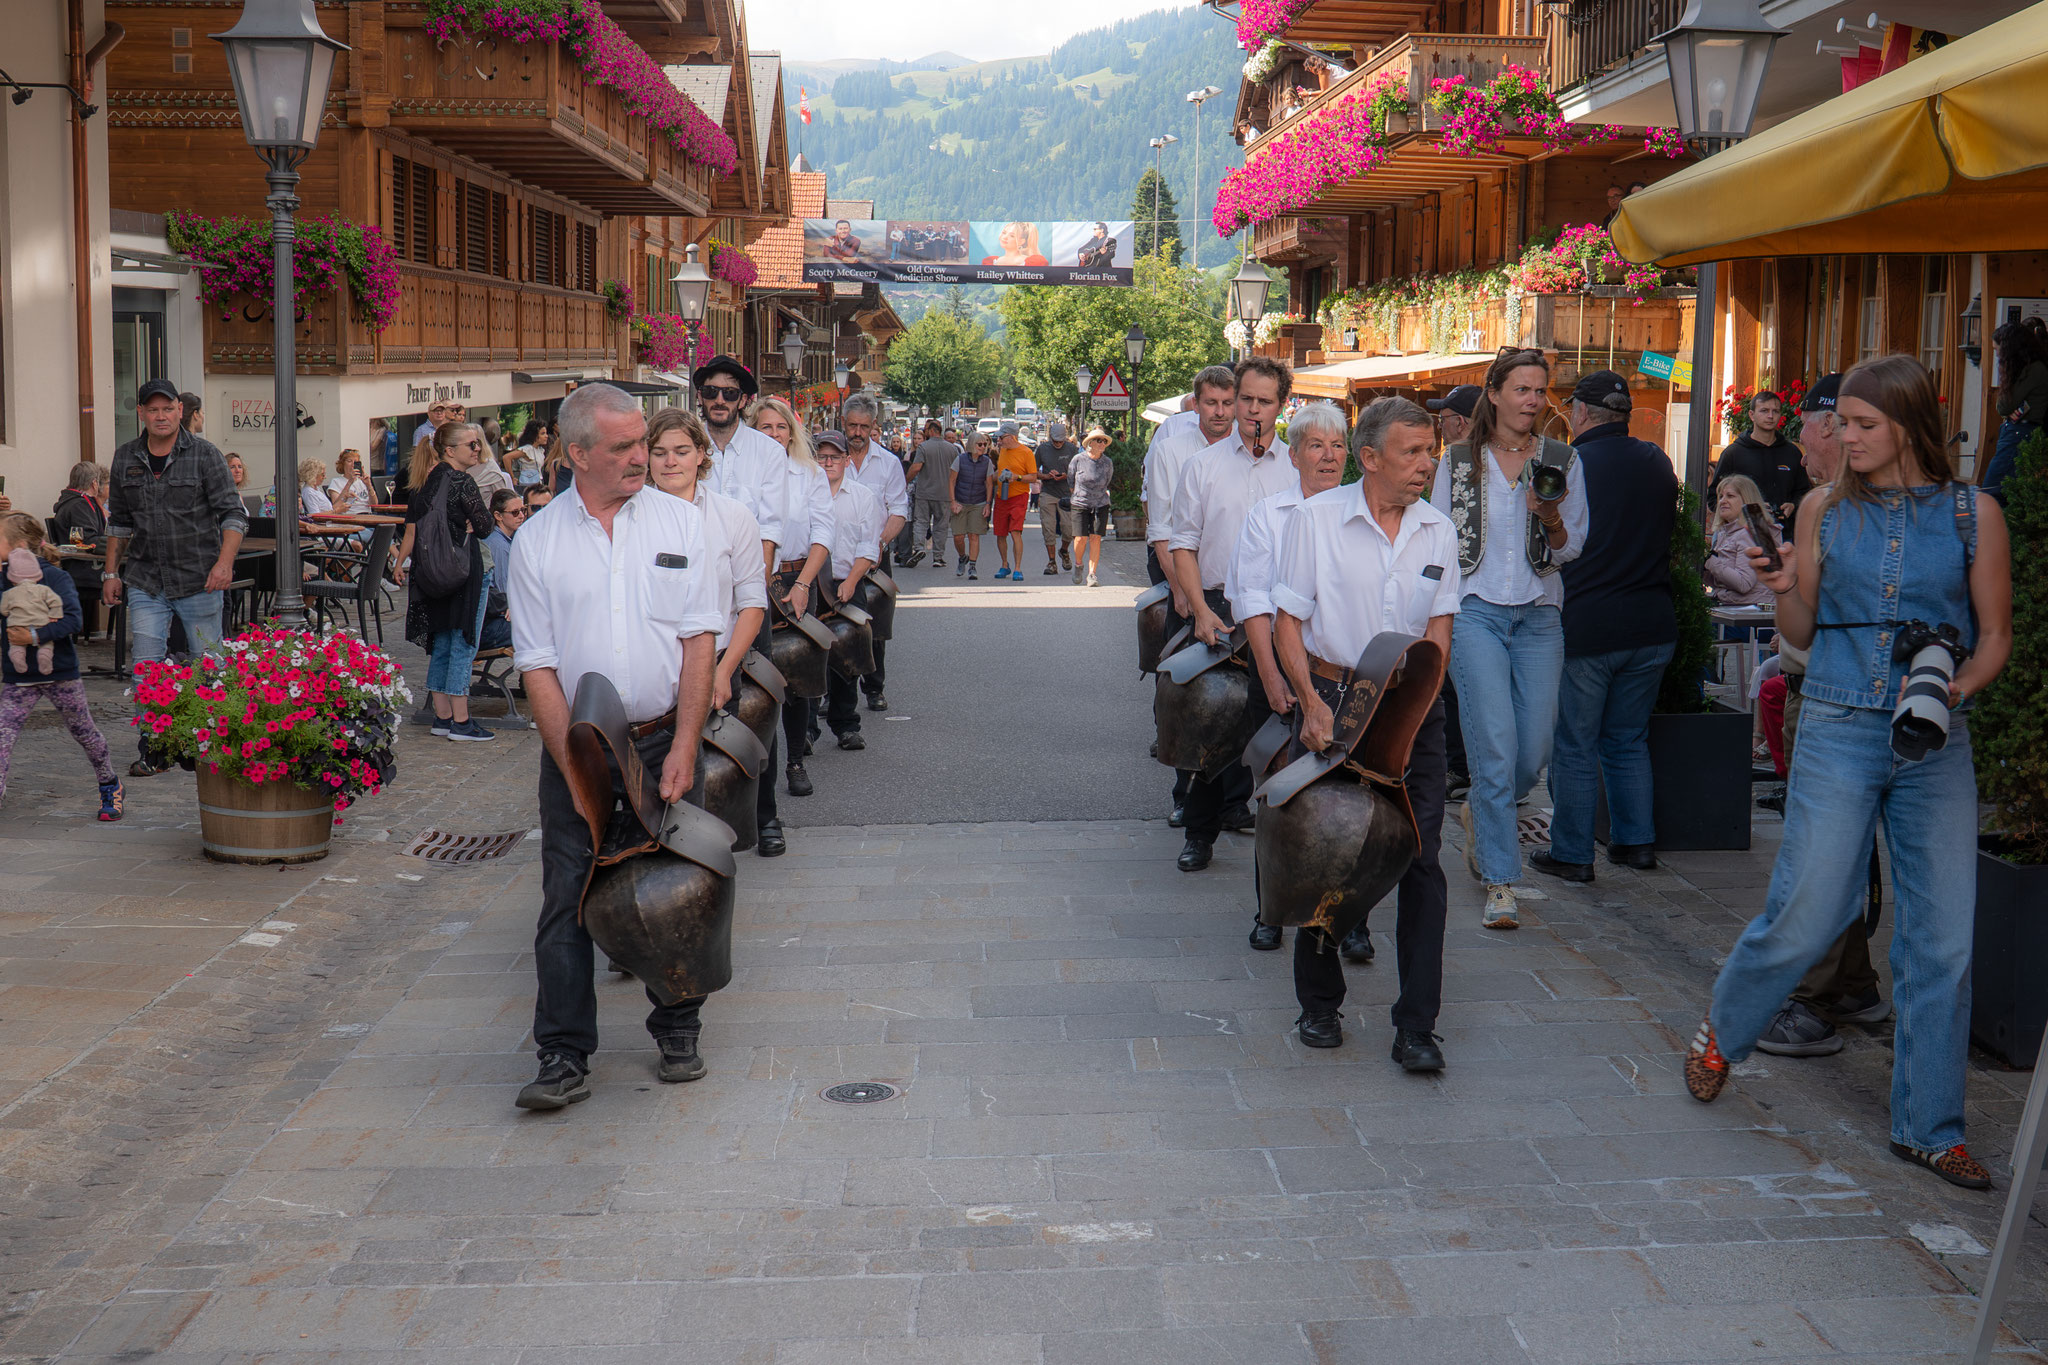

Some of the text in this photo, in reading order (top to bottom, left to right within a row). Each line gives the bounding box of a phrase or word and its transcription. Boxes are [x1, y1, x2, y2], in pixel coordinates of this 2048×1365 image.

[808, 268, 878, 279] Scotty McCreery
[906, 265, 947, 274] Old Crow
[894, 273, 960, 283] Medicine Show
[976, 270, 1045, 281] Hailey Whitters
[1069, 272, 1118, 281] Florian Fox
[1644, 356, 1671, 371] E-Bike
[232, 399, 275, 414] PIZZA
[1092, 399, 1129, 408] Senksäulen
